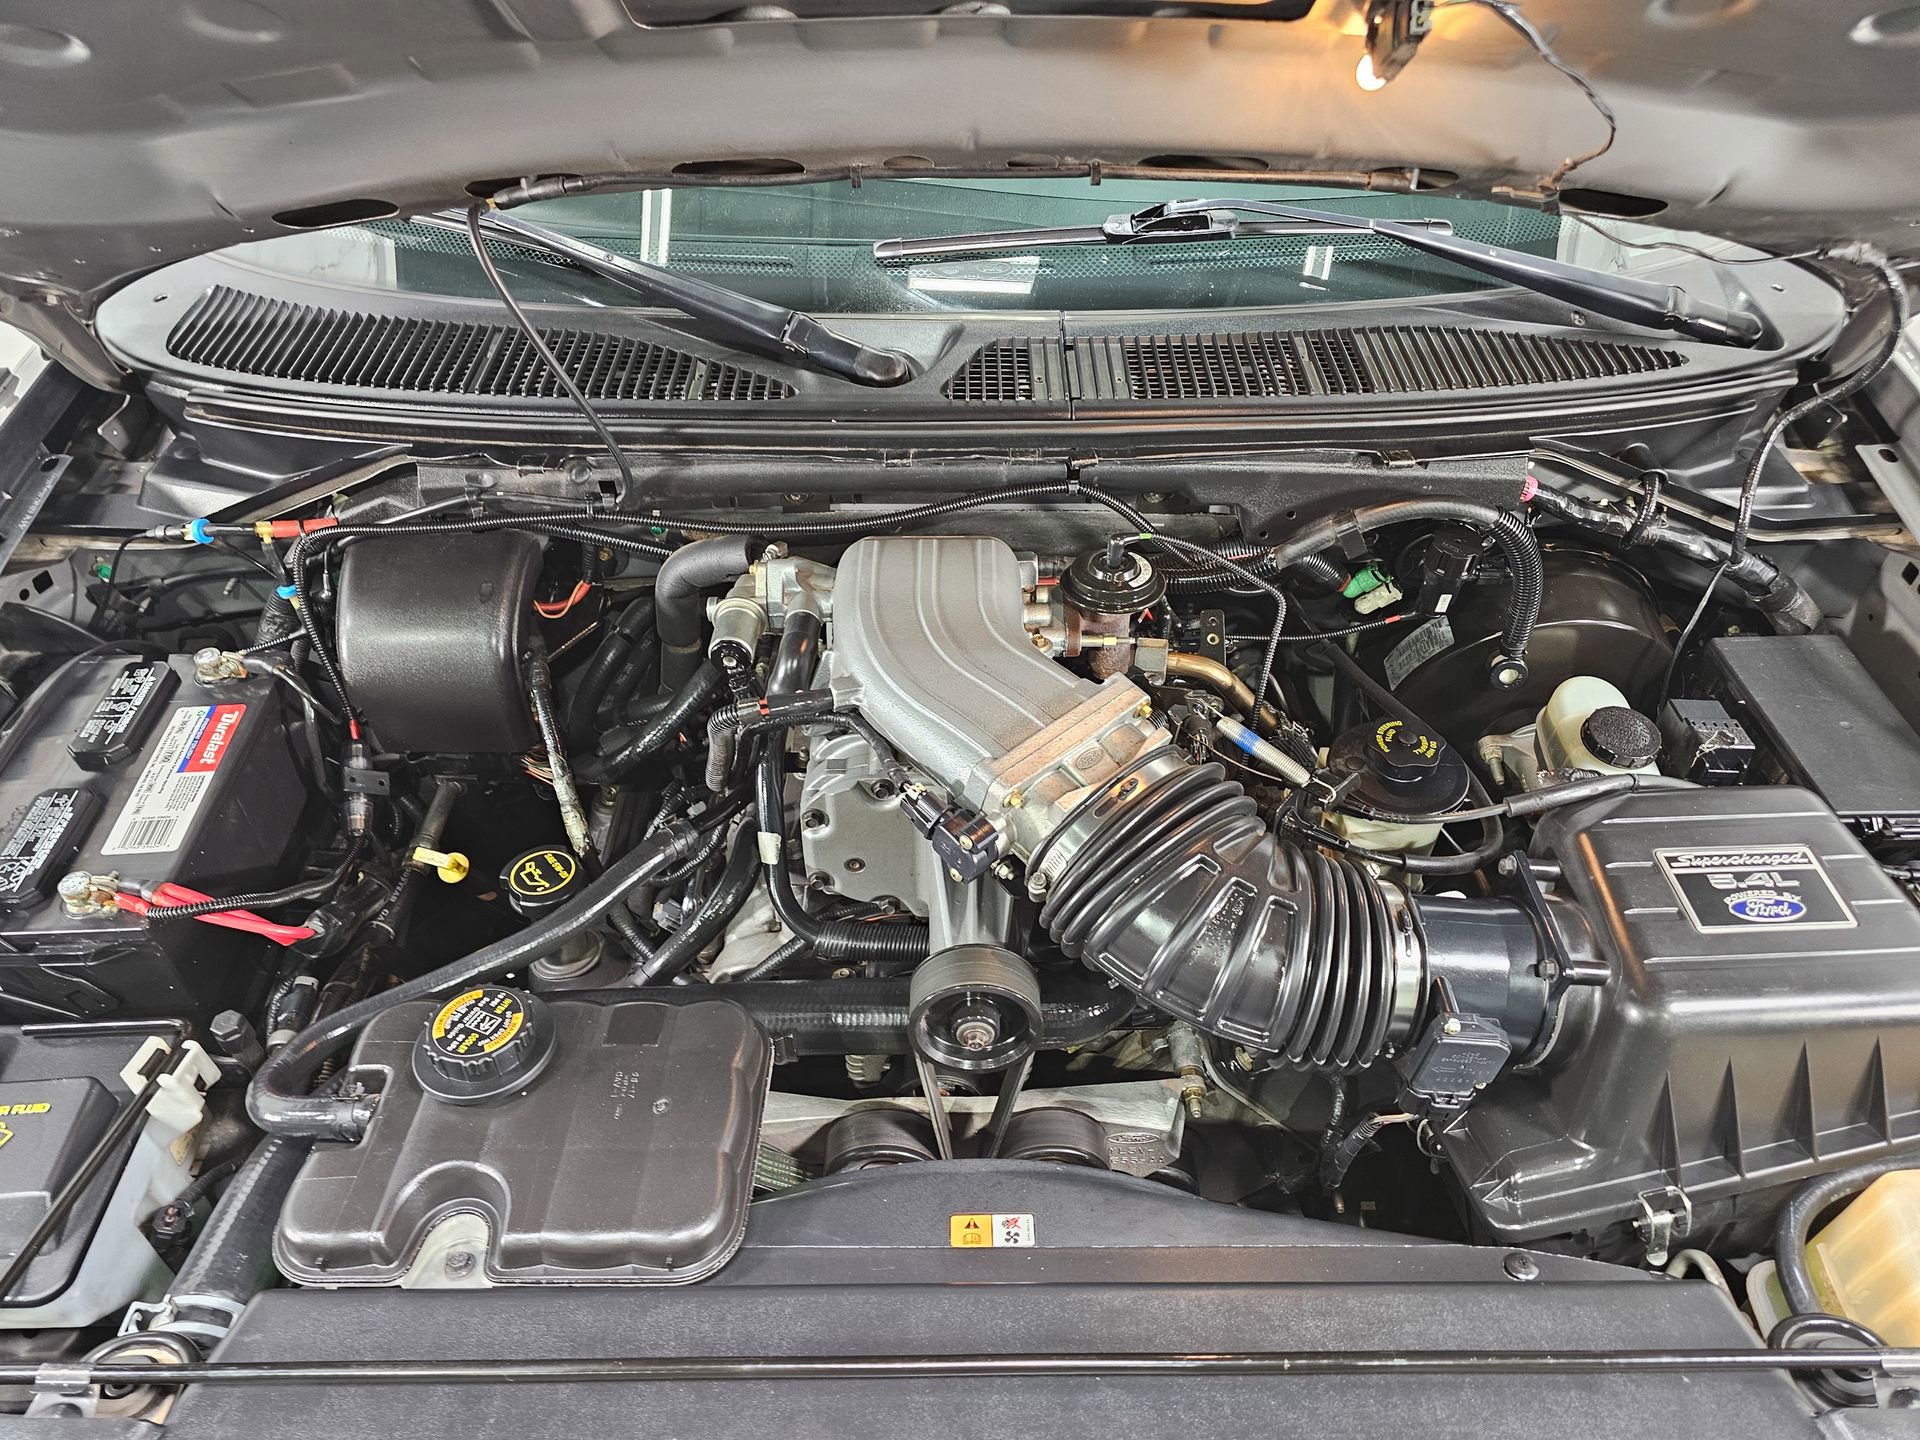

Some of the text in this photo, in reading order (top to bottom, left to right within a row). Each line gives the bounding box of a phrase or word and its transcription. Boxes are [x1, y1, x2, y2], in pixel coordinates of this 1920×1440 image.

[199, 710, 240, 765] Duralast
[1376, 720, 1403, 753] POWER STEERING
[1385, 728, 1396, 742] FLUID
[1670, 851, 1809, 869] Supercharged
[1706, 871, 1800, 890] 5.4L
[1722, 889, 1777, 904] POWERED
[1745, 898, 1792, 917] Ford
[494, 998, 513, 1015] INTER
[456, 1032, 480, 1054] COOLER
[11, 1102, 51, 1115] FLUID
